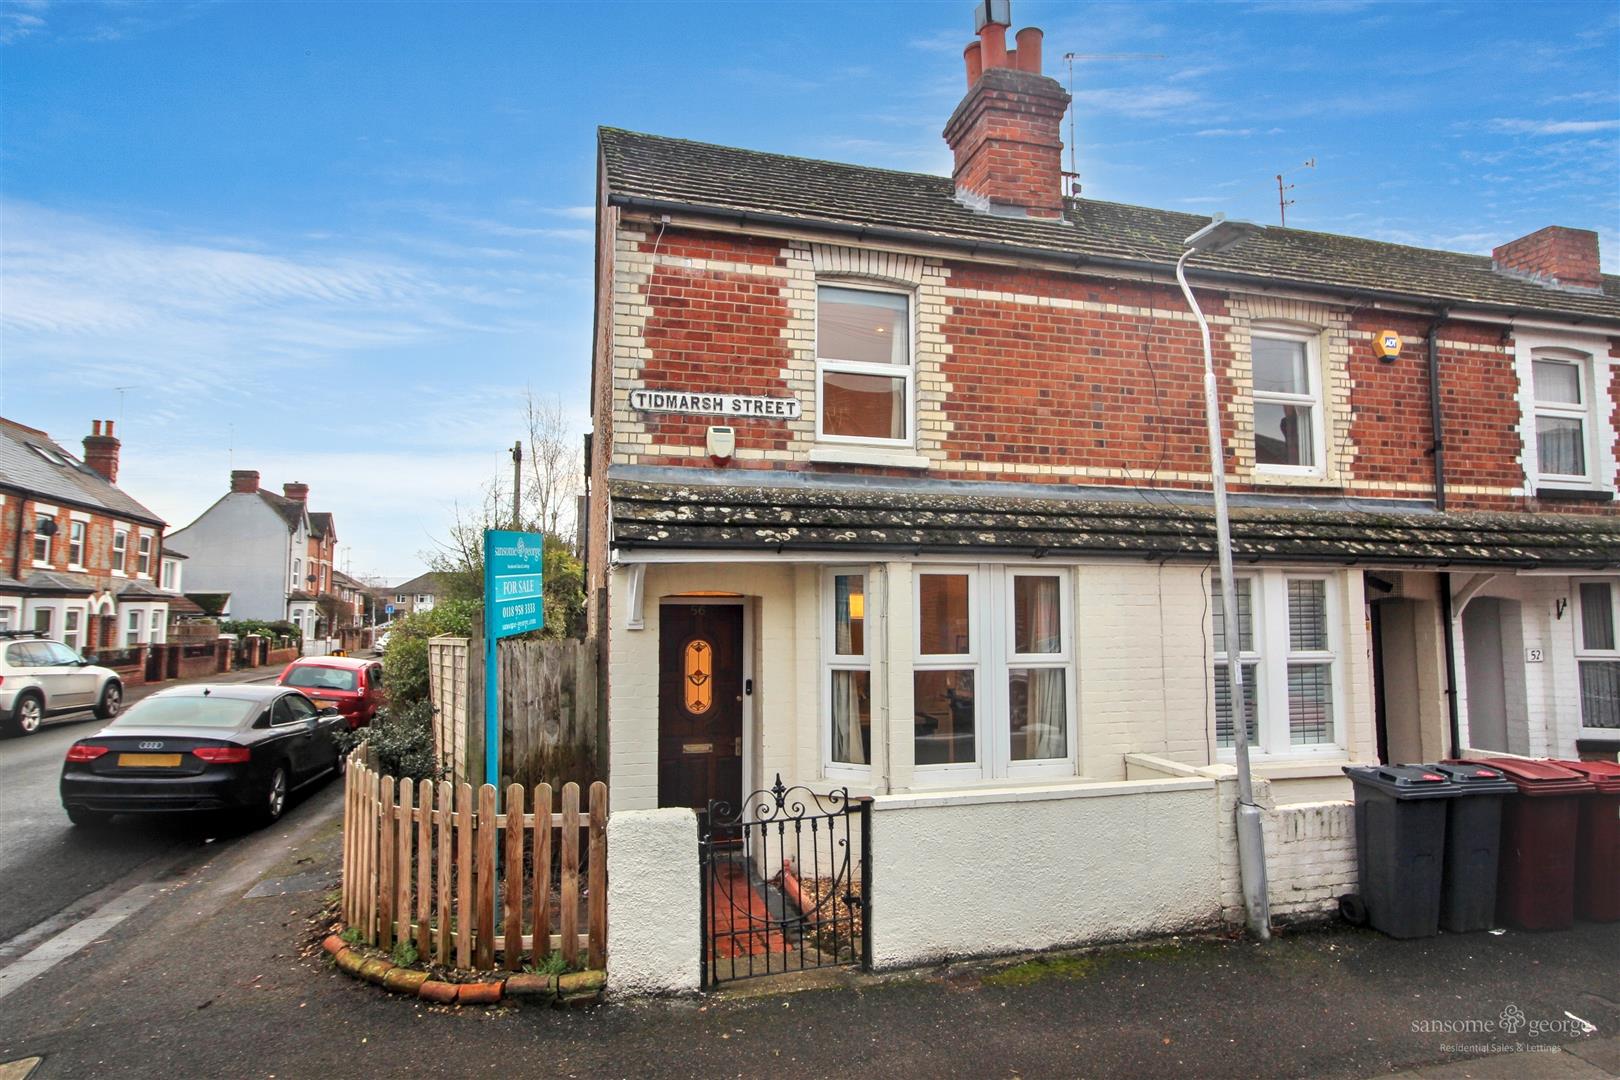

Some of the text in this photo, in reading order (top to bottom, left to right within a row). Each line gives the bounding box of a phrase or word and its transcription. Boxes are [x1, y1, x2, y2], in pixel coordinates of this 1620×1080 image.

[1385, 338, 1396, 347] ADT
[637, 393, 796, 415] TIDMARSH STREET
[503, 580, 534, 596] FOR SALE
[503, 606, 515, 618] 0118
[1531, 650, 1541, 660] 52
